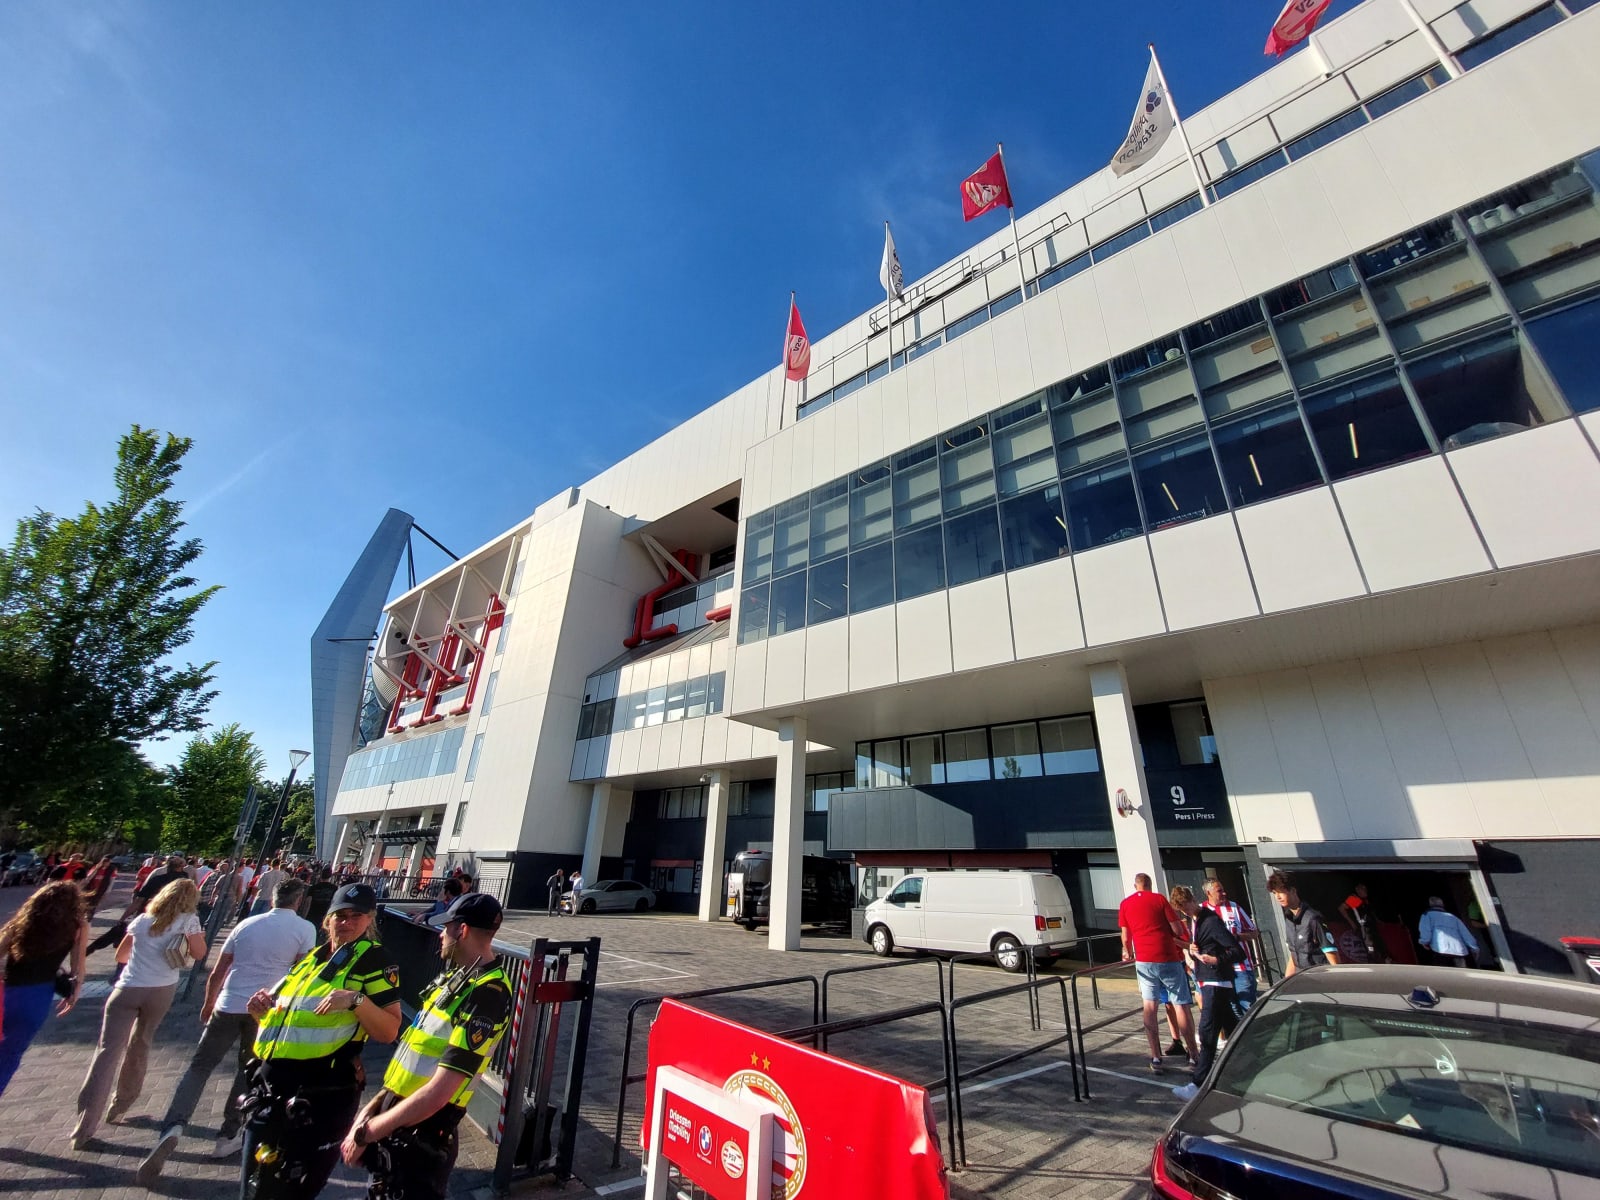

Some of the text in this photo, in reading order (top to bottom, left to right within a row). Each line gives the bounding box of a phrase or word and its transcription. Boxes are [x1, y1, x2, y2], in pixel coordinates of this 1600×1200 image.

[1170, 785, 1186, 805] 9
[1196, 812, 1215, 820] Press
[669, 1108, 692, 1130] Driessen
[669, 1119, 691, 1144] Mobility
